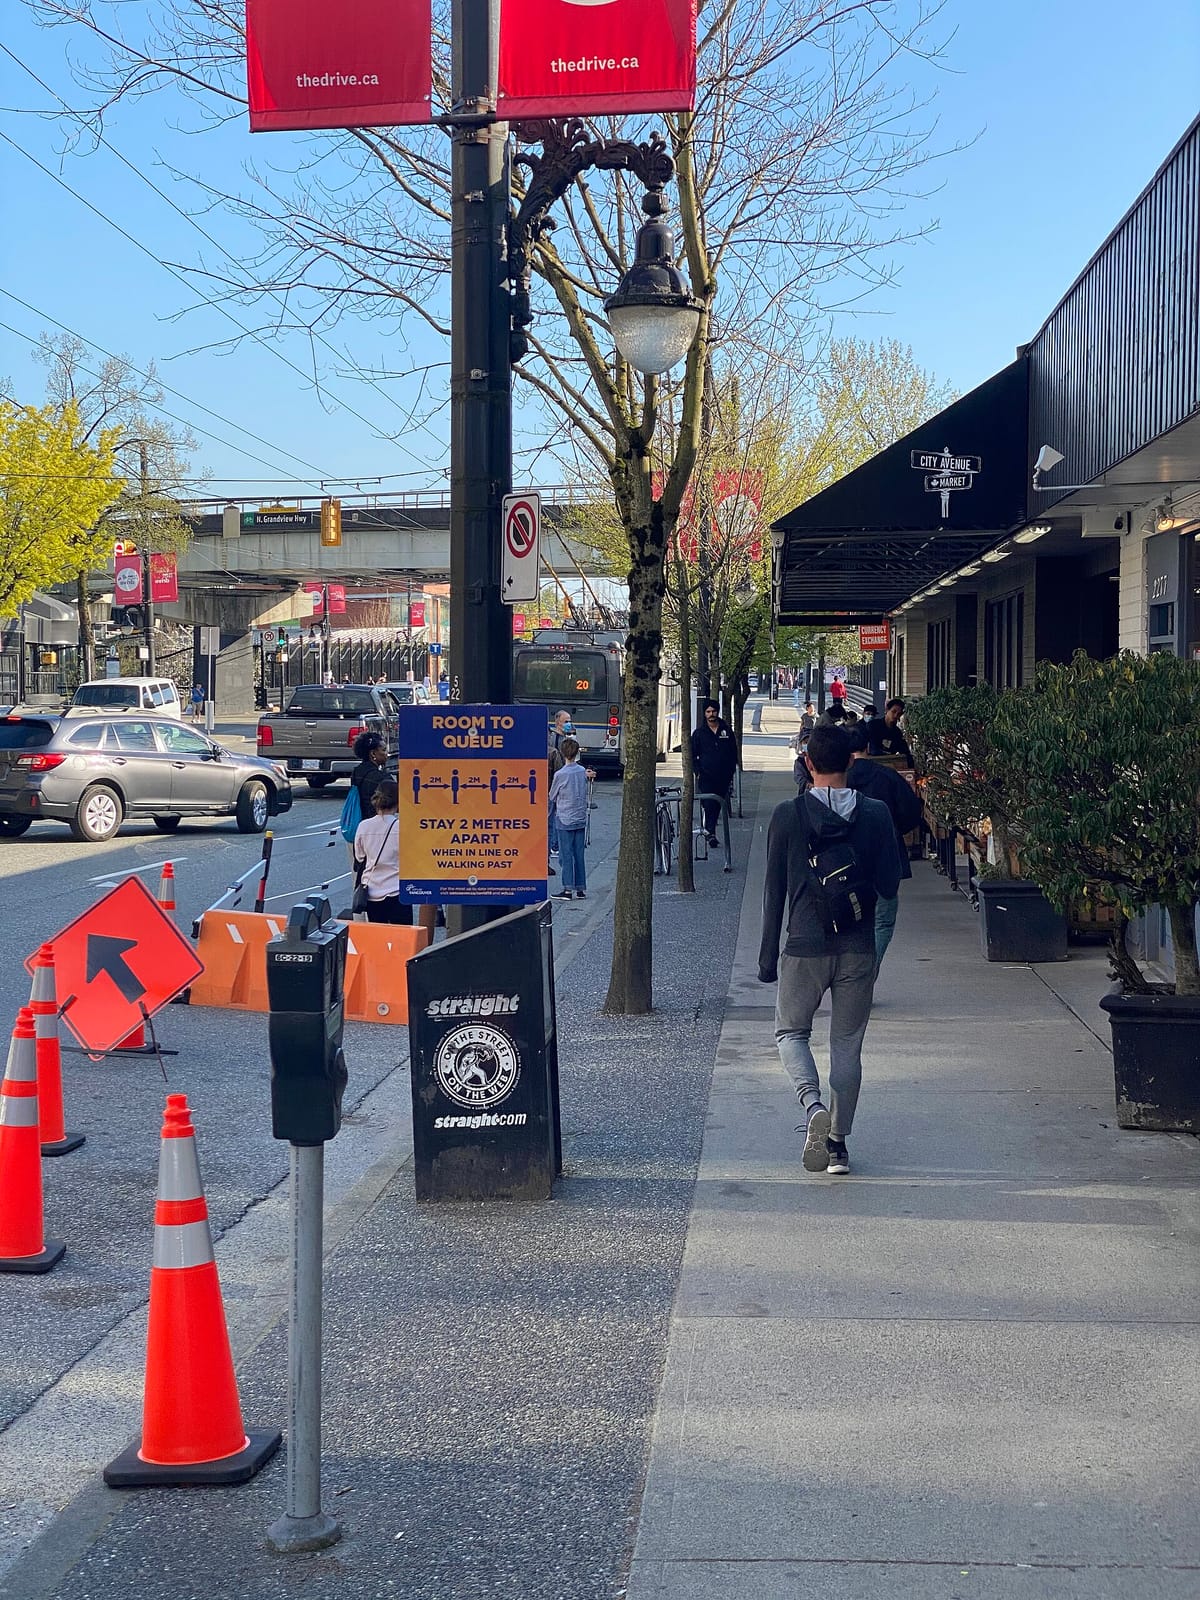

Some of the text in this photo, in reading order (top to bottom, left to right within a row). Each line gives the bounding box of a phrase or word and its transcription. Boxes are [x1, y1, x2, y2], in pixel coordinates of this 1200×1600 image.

[550, 55, 640, 73] thedrive.ca
[296, 72, 379, 88] thedrive.ca
[920, 455, 971, 471] CITY AVENUE
[939, 476, 966, 488] MARKET
[263, 514, 294, 523] Grandview
[294, 514, 307, 524] Hwy
[431, 644, 440, 653] T
[453, 675, 459, 688] 5
[576, 680, 589, 690] 20
[451, 687, 460, 700] 22
[432, 715, 515, 730] ROOM TO
[442, 734, 504, 749] QUEUE
[429, 776, 519, 784] 2M 2M 2M
[419, 818, 530, 830] STAY 2 METRES
[450, 833, 500, 845] APART
[431, 848, 519, 857] WHEN IN LINE OR
[437, 860, 513, 869] WALKING PAST
[425, 994, 520, 1016] straight
[443, 1040, 459, 1060] ON
[454, 1031, 474, 1048] THE
[478, 1031, 511, 1059] STREET
[448, 1077, 463, 1093] ON
[465, 1089, 486, 1100] THE
[488, 1075, 509, 1095] WEB
